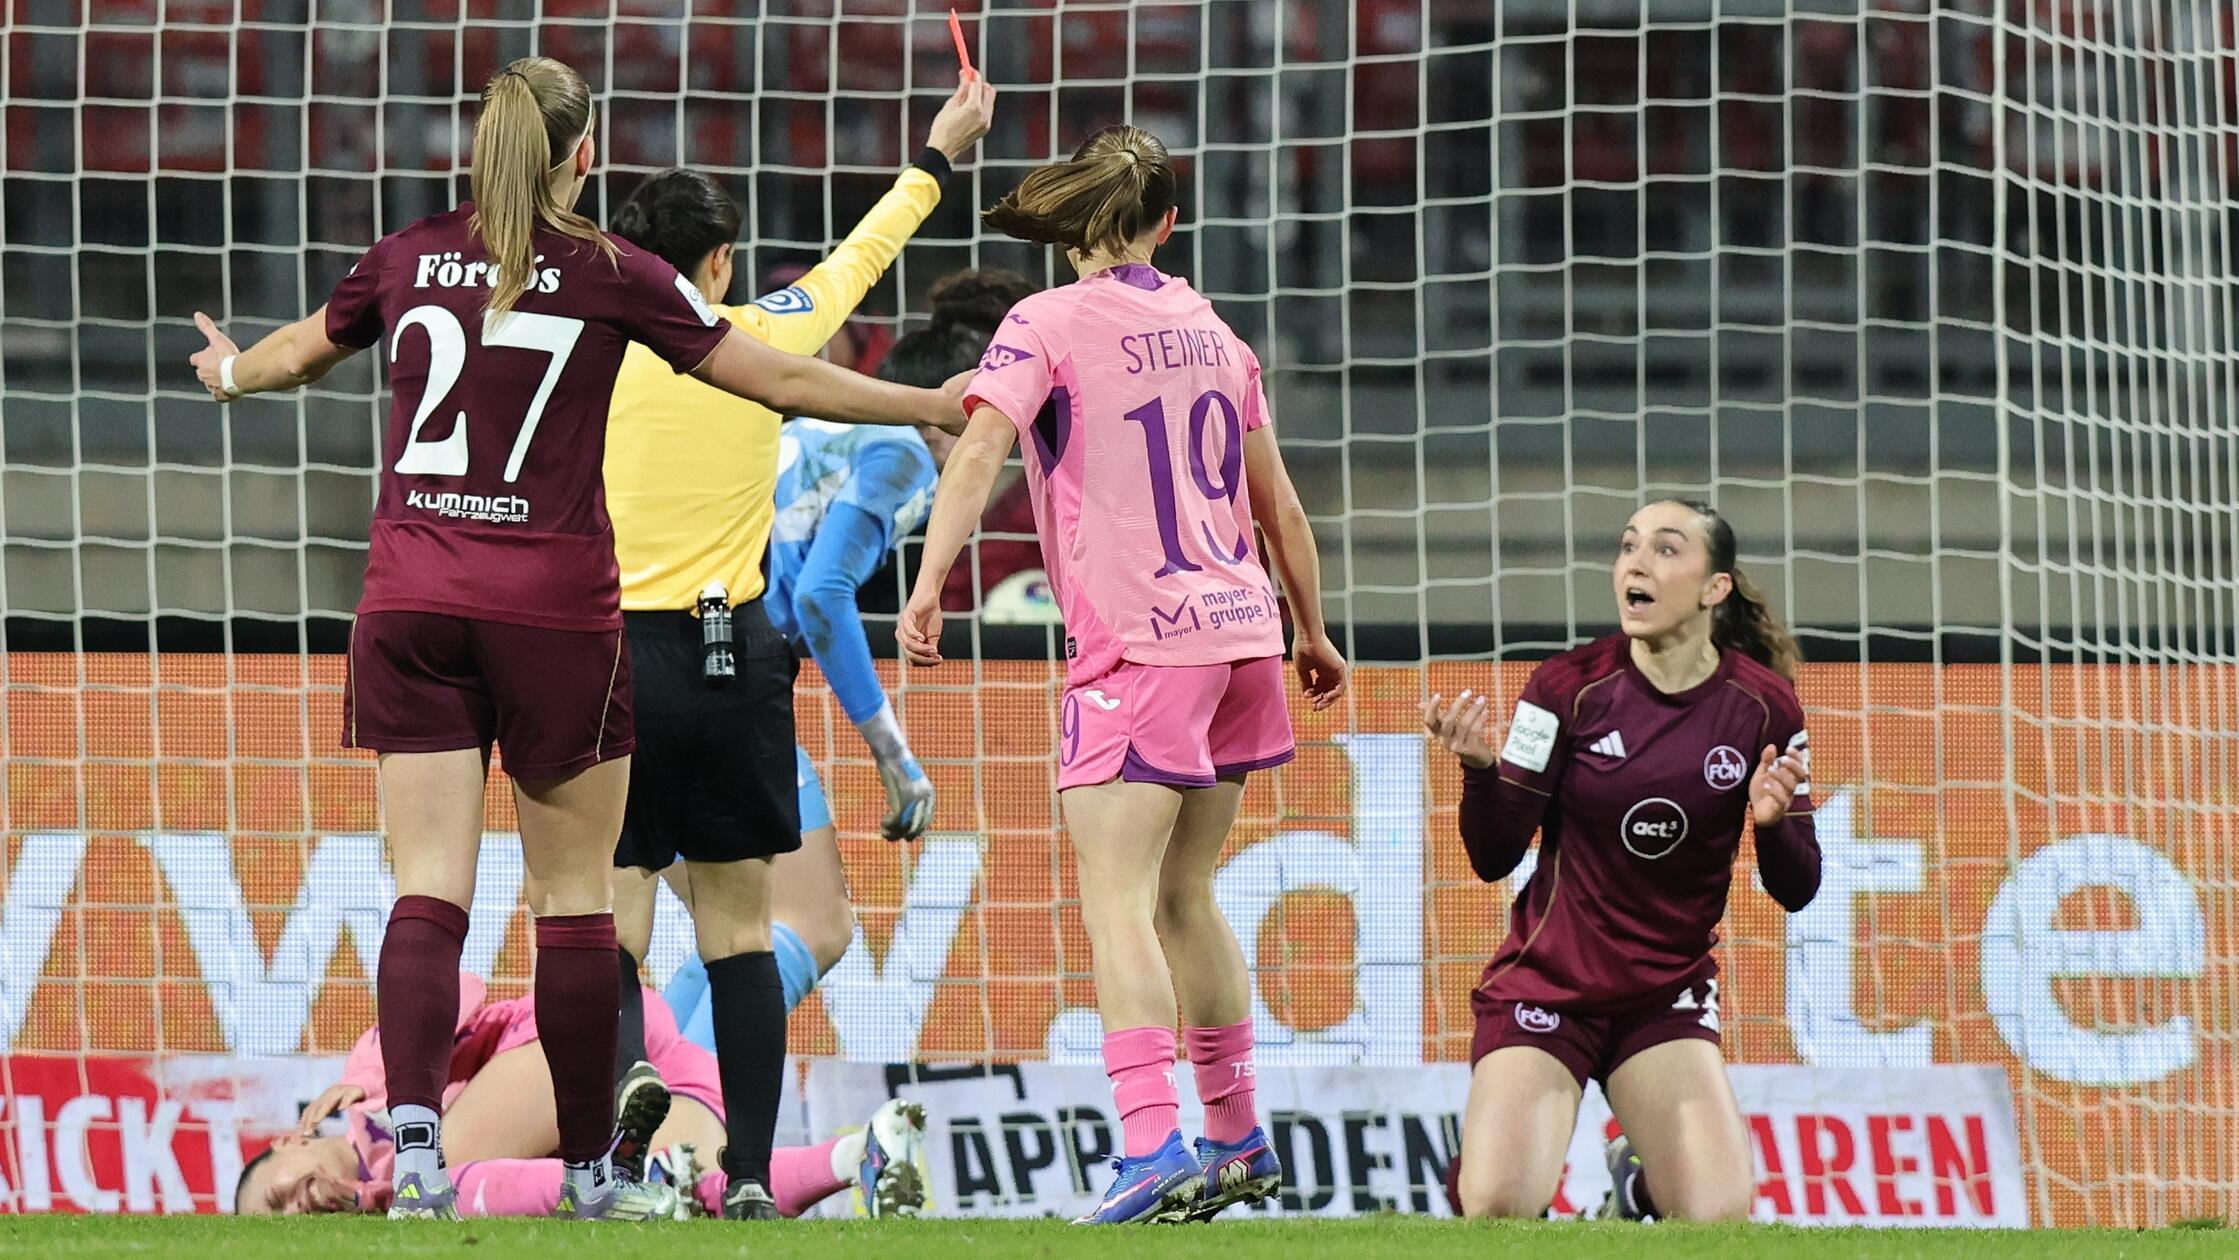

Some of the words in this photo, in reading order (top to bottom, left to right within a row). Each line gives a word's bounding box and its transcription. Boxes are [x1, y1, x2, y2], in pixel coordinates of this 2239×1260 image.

[414, 251, 561, 293] Förs
[1120, 328, 1231, 375] STEINER
[391, 305, 585, 483] 27
[1124, 389, 1249, 578] 19
[438, 507, 529, 523] Fahrzeugwelt
[1209, 604, 1263, 630] gruppe
[1709, 762, 1741, 780] FCN
[1231, 1061, 1256, 1079] TS
[0, 1093, 249, 1214] ICKT
[948, 1104, 1113, 1208] APP
[1252, 1110, 1467, 1212] DEN
